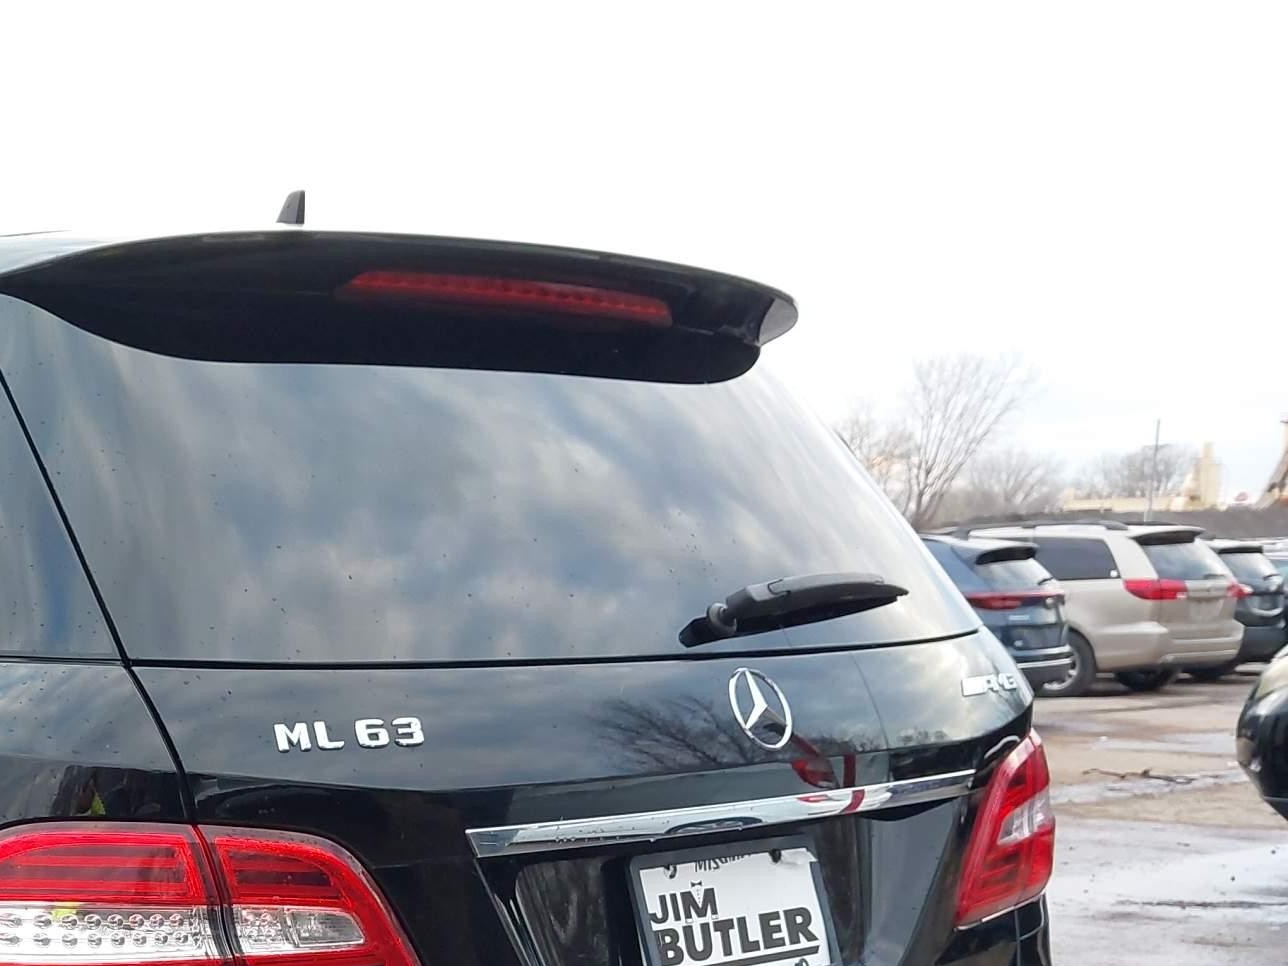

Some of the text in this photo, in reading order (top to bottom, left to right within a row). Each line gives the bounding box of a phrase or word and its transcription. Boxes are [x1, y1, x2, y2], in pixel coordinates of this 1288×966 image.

[273, 717, 425, 753] ML 63
[650, 888, 718, 925] JIM
